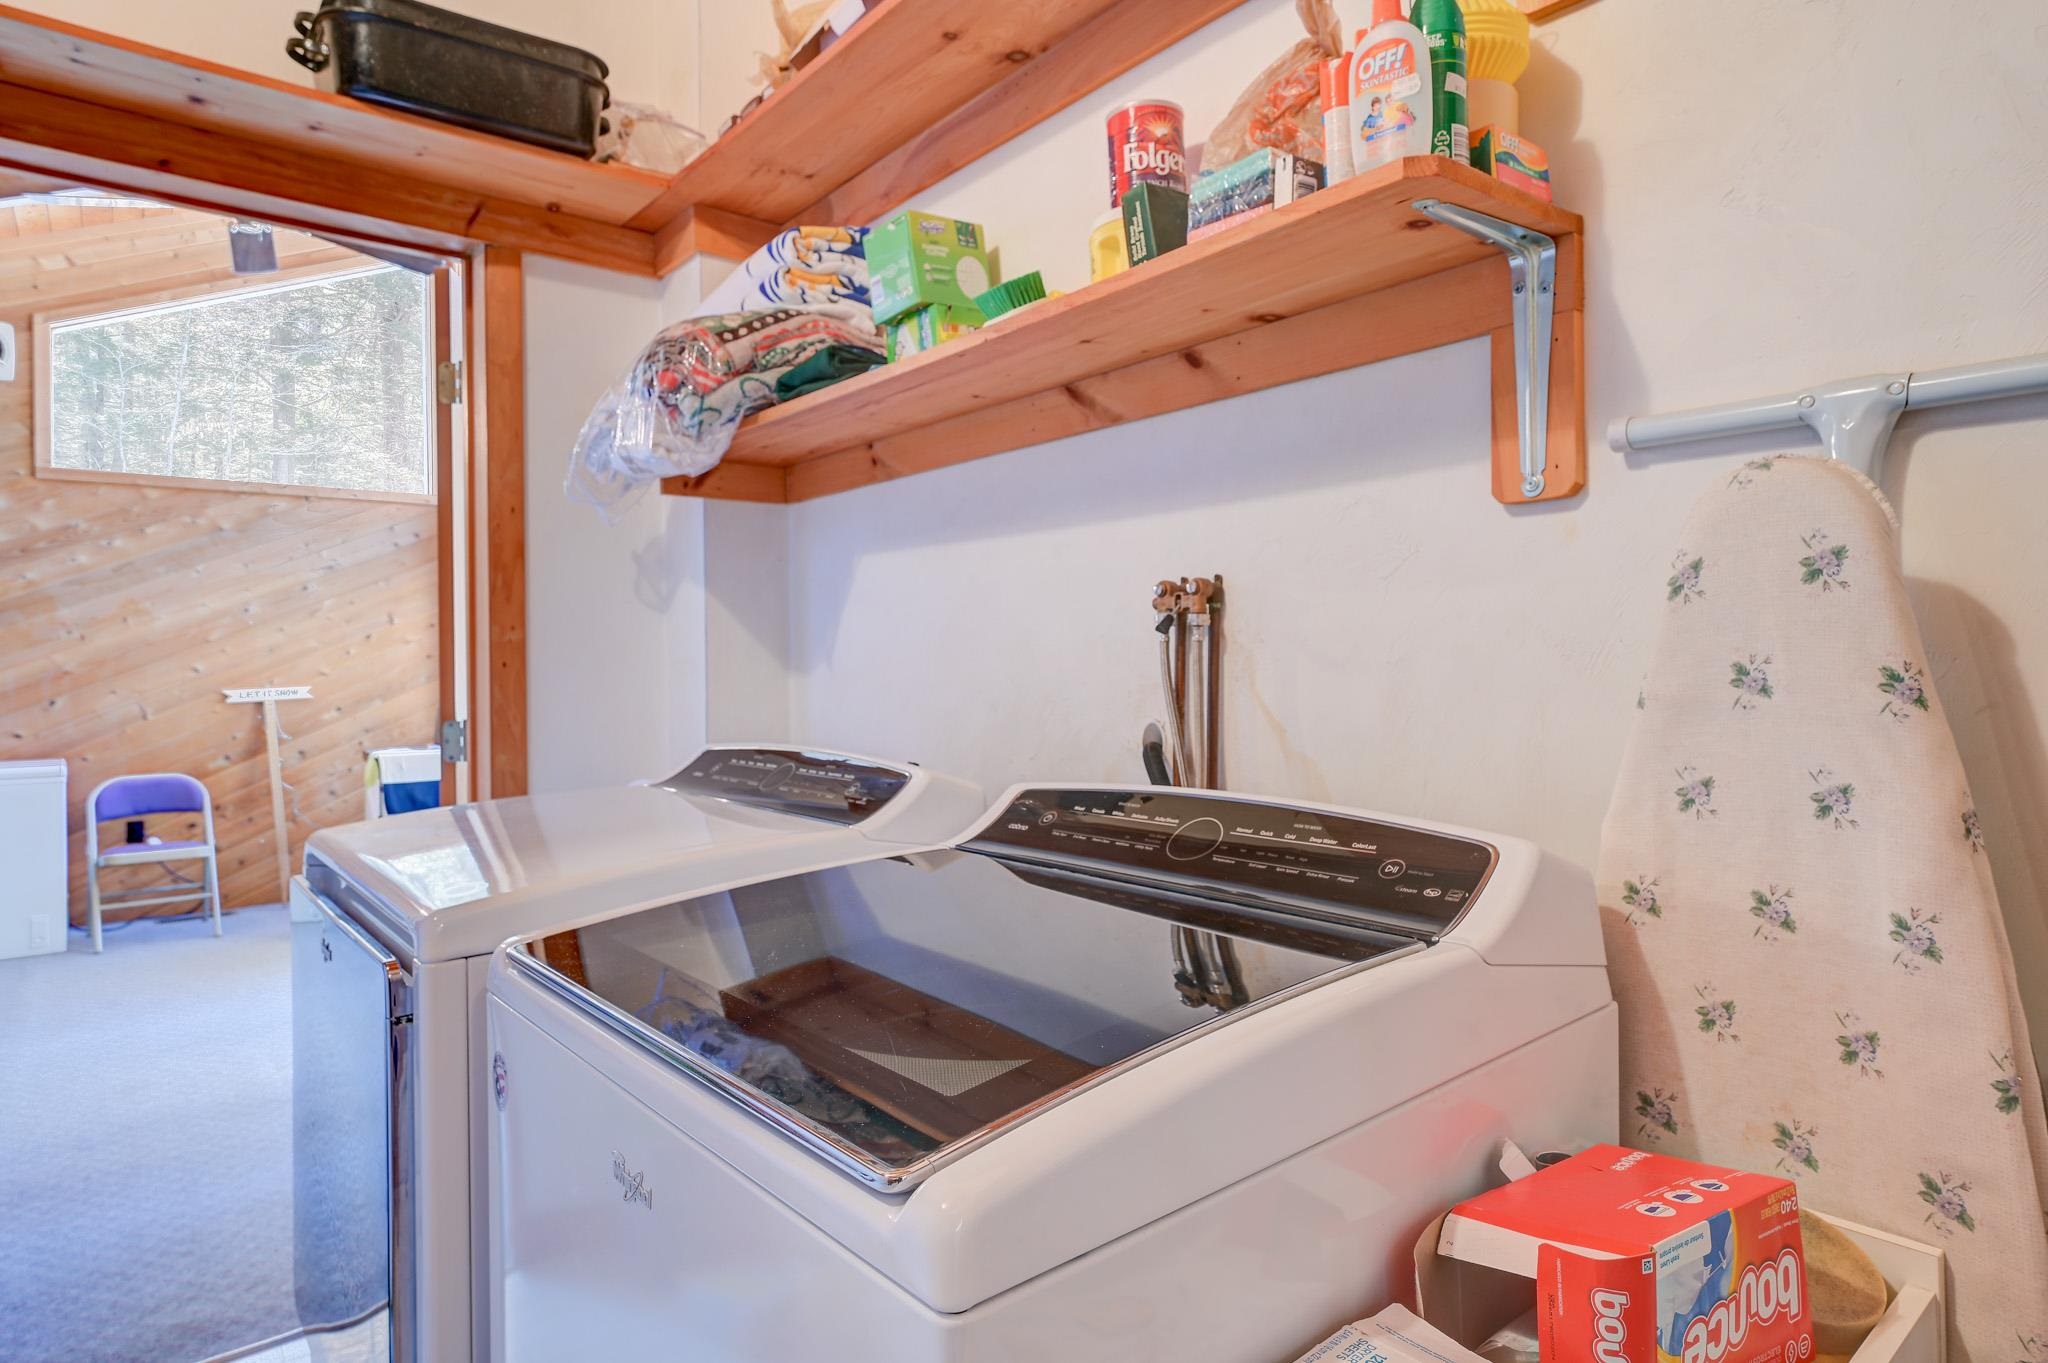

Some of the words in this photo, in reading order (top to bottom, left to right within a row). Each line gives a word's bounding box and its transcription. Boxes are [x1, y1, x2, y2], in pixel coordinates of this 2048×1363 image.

[1359, 43, 1407, 80] OFF!
[1360, 67, 1409, 89] SKINTASTIC
[1123, 143, 1185, 175] Folger
[1309, 836, 1323, 844] Deep
[1323, 838, 1338, 846] Water
[1351, 842, 1377, 851] ColorLast
[1781, 1196, 1798, 1214] 240
[1685, 1253, 1799, 1363] bounce
[1593, 1288, 1630, 1363] bou
[1336, 1338, 1368, 1361] SHEETS
